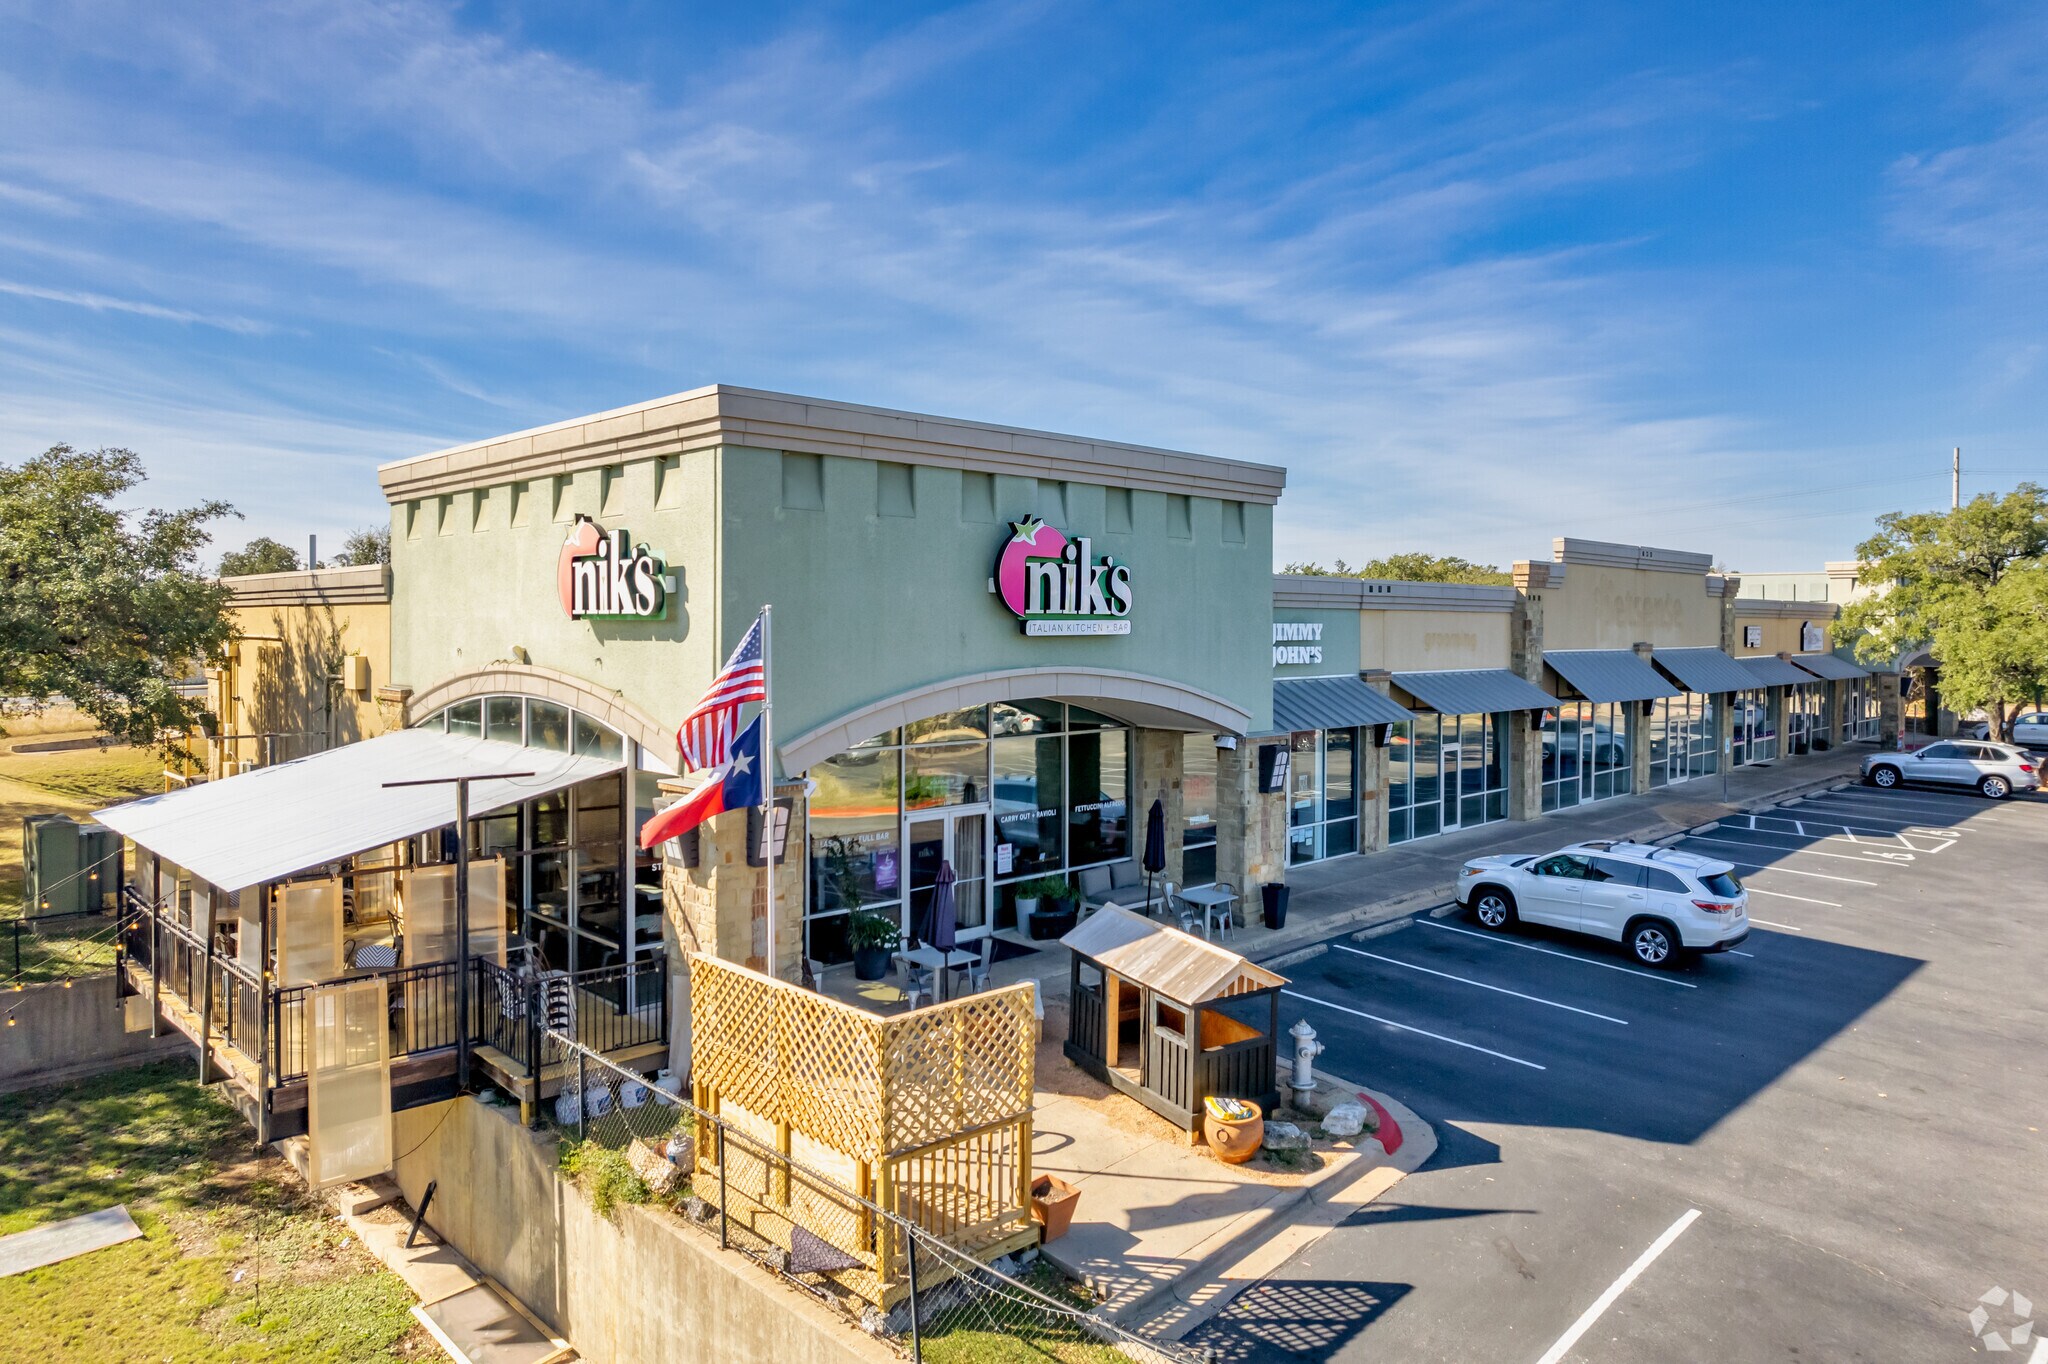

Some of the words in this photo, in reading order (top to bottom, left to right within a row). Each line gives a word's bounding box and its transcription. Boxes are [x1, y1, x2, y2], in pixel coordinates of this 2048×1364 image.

[572, 529, 656, 616] nik's
[1025, 537, 1133, 617] nik's
[1029, 623, 1063, 632] ITALIAN
[1066, 623, 1103, 632] KITCHEN
[1113, 623, 1129, 631] BAR
[1273, 623, 1323, 645] JIMMY
[1273, 646, 1322, 668] JOHN'S
[1001, 812, 1019, 823] CARRY
[1020, 811, 1030, 820] OUT
[1036, 809, 1057, 818] RAVIOLI
[875, 831, 890, 840] BAR
